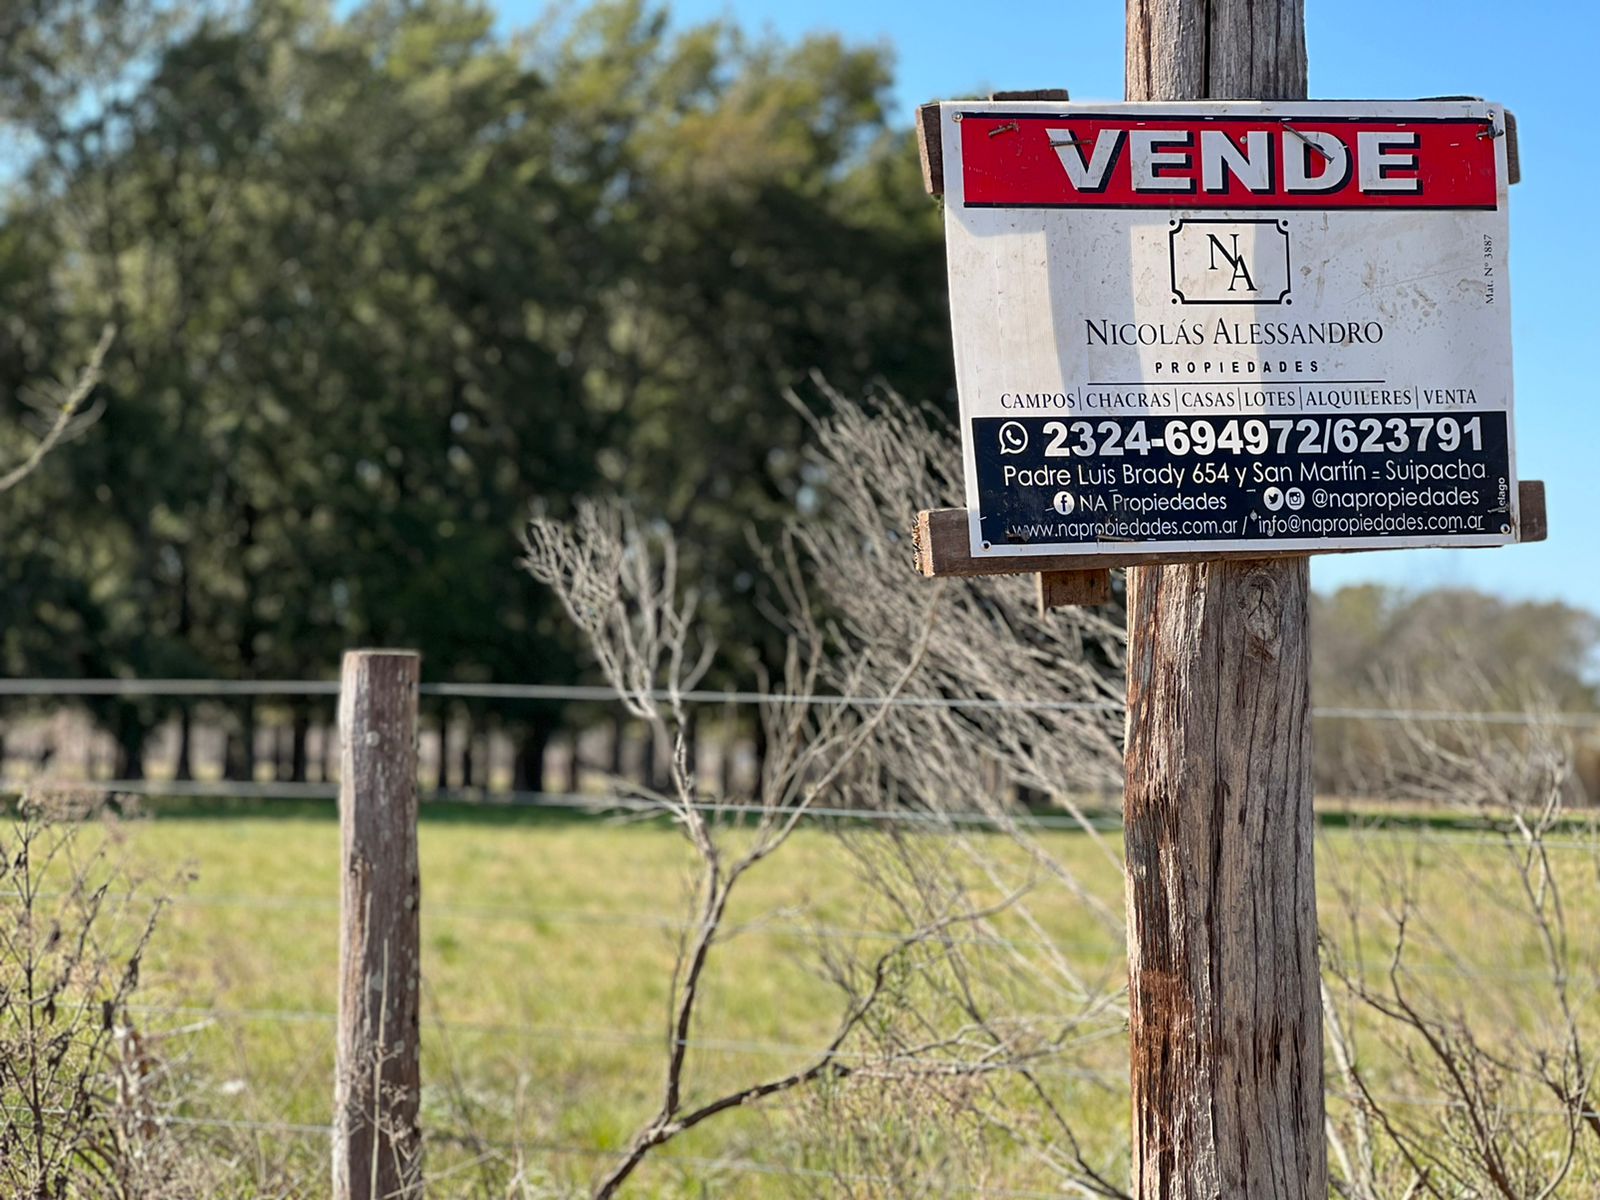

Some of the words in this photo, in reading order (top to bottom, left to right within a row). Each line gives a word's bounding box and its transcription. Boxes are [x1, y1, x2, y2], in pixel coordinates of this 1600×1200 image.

[1045, 128, 1423, 195] VENDE
[1483, 233, 1494, 260] 3887
[1485, 280, 1495, 304] Mat.
[1155, 360, 1319, 374] PROPIEDADES
[1001, 392, 1076, 409] CAMPOS
[1086, 391, 1172, 408] CHACRAS
[1182, 391, 1235, 408] CASAS
[1244, 390, 1296, 407] LOTES
[1306, 389, 1412, 409] ALQUILERES
[1423, 388, 1478, 405] VENTA
[1042, 416, 1483, 457] 2324-694972/623791
[1004, 463, 1072, 486] Padre
[1078, 464, 1116, 486] Luis
[1124, 462, 1185, 489] Brady
[1191, 462, 1230, 484] 654
[1234, 466, 1248, 489] y
[1253, 460, 1293, 483] San
[1300, 459, 1367, 482] Martín
[1385, 458, 1486, 484] Suipacha
[1080, 495, 1108, 512] NA
[1112, 492, 1228, 515] Propiedades
[1311, 486, 1480, 511] @napropiedades
[1011, 515, 1238, 541] www.napropiedades.com.ar
[1257, 512, 1484, 538] info@napropiedades.com.ar
